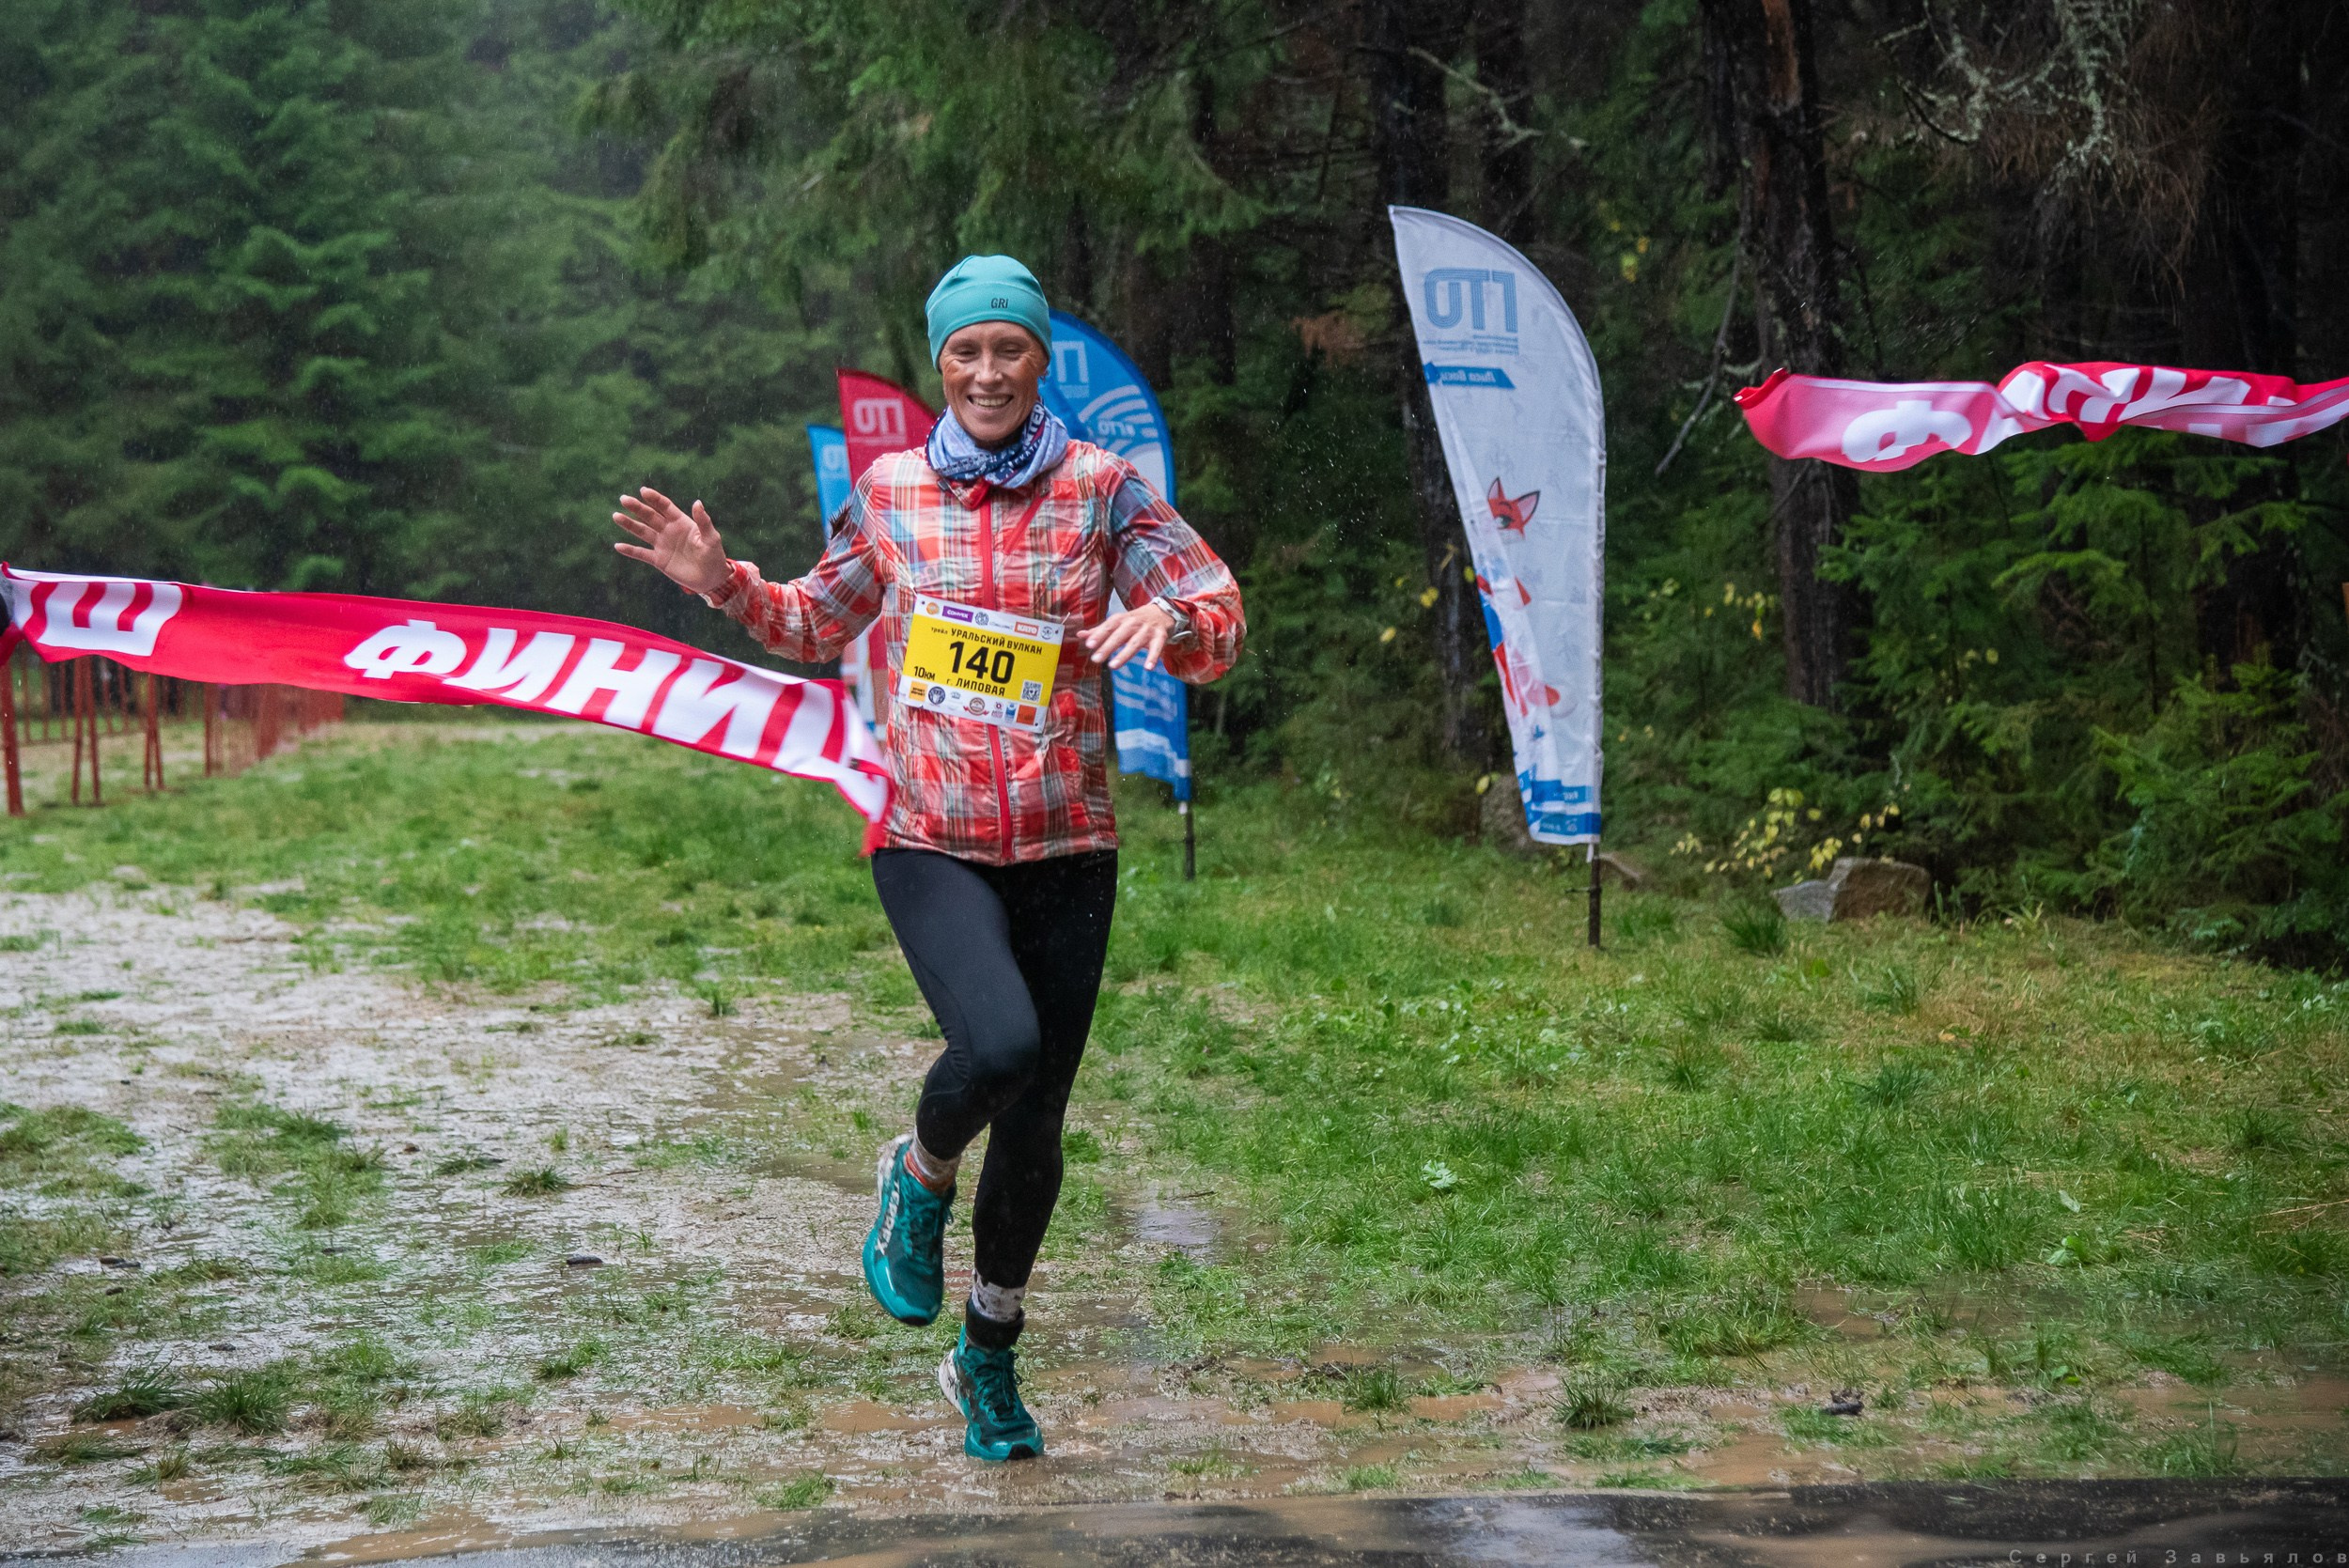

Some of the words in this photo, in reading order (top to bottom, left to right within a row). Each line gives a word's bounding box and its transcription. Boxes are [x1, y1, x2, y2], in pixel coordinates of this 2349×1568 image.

[990, 297, 1009, 309] GRI
[951, 628, 1005, 647] УРАЛЬСКИЙ
[1006, 640, 1043, 655] ВУЛКАН
[949, 641, 1016, 684] 140
[956, 677, 1005, 696] ЛИПОВАЯ
